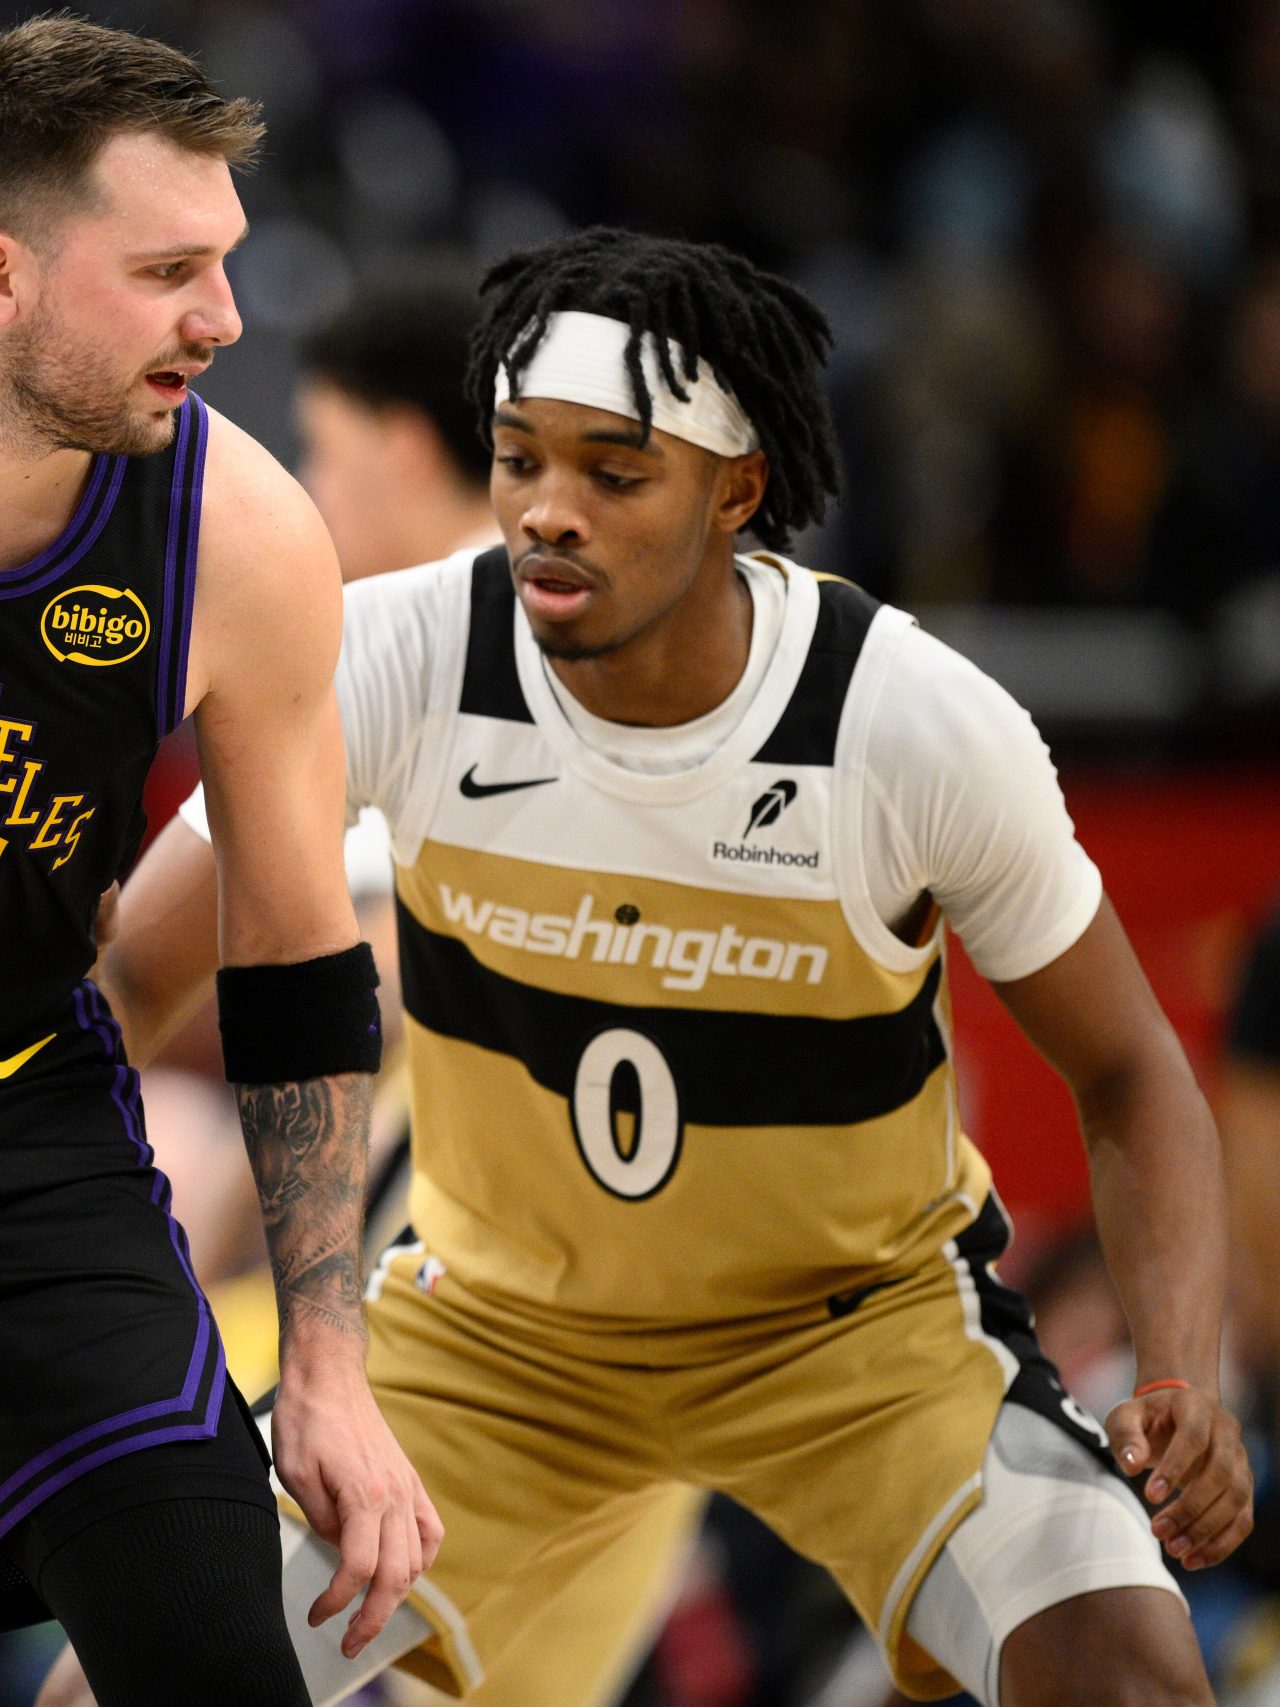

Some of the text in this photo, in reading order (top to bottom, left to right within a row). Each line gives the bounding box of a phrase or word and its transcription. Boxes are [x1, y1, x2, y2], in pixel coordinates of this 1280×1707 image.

[51, 604, 143, 645] bibigo
[64, 631, 102, 649] 비비고
[713, 841, 819, 869] Robinhood
[438, 884, 829, 991] washington
[570, 1026, 686, 1202] 0
